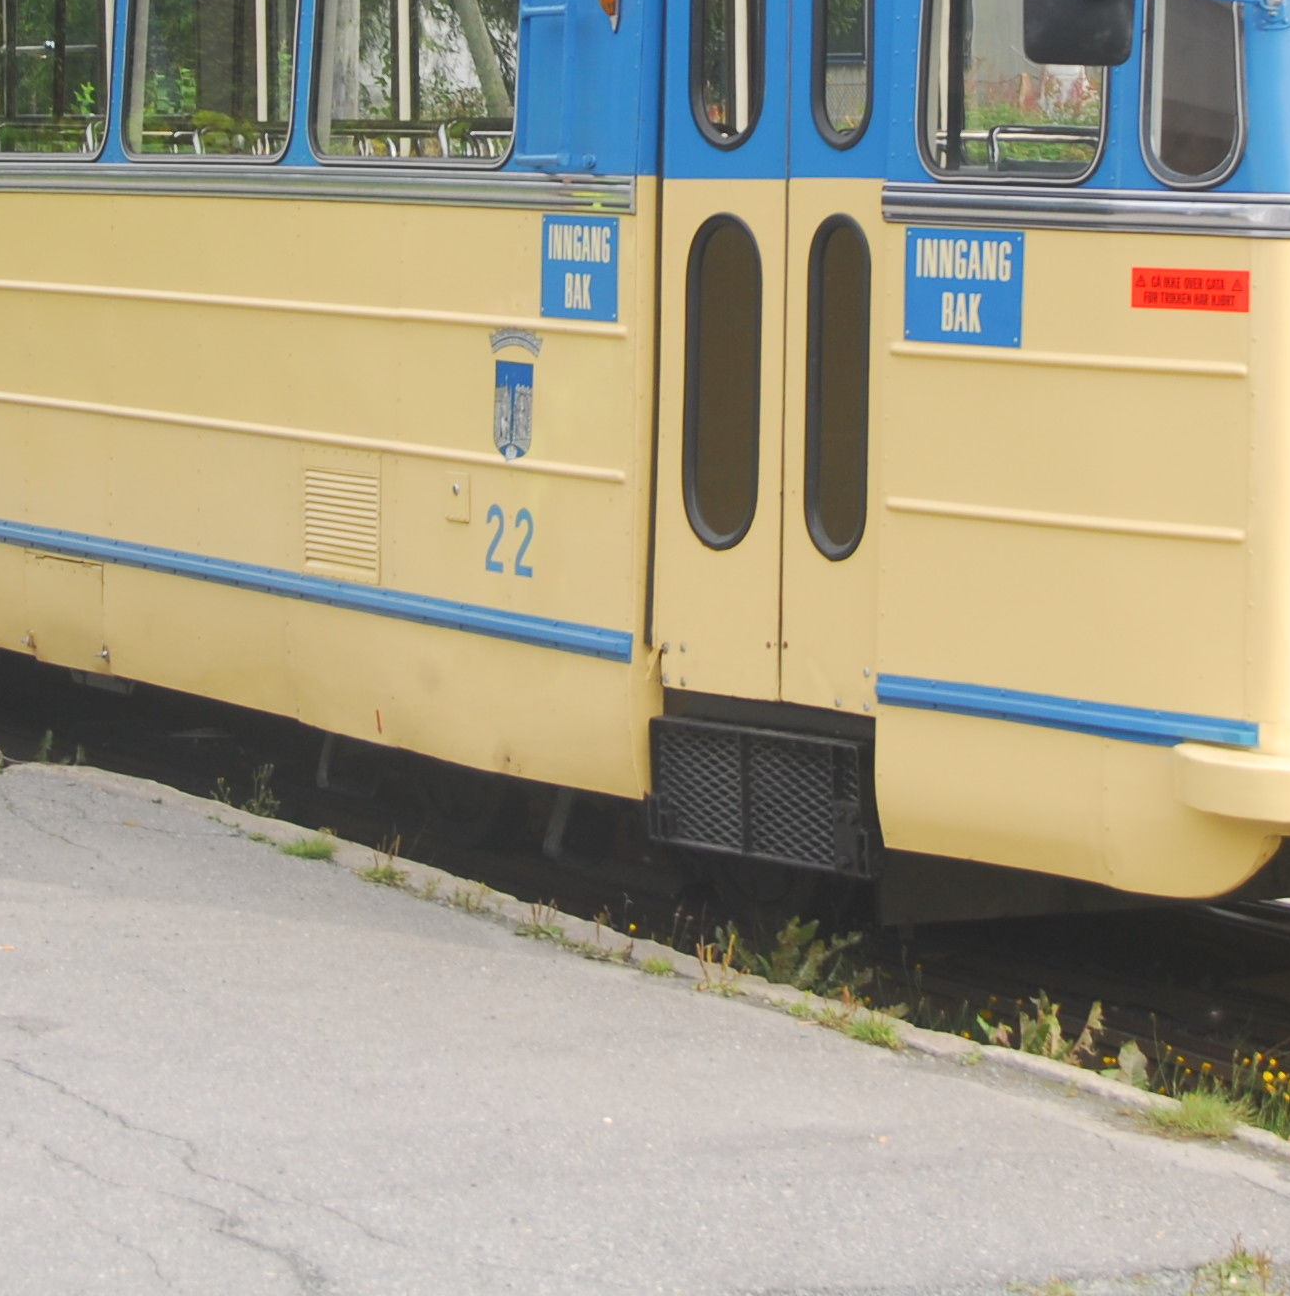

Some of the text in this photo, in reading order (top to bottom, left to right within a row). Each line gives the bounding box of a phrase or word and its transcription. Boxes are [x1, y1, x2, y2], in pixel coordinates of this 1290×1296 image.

[548, 224, 611, 264] INNGANG
[915, 237, 1012, 283] INNGANG
[564, 272, 591, 310] BAK
[941, 292, 982, 334] BAK
[485, 504, 534, 578] 22
